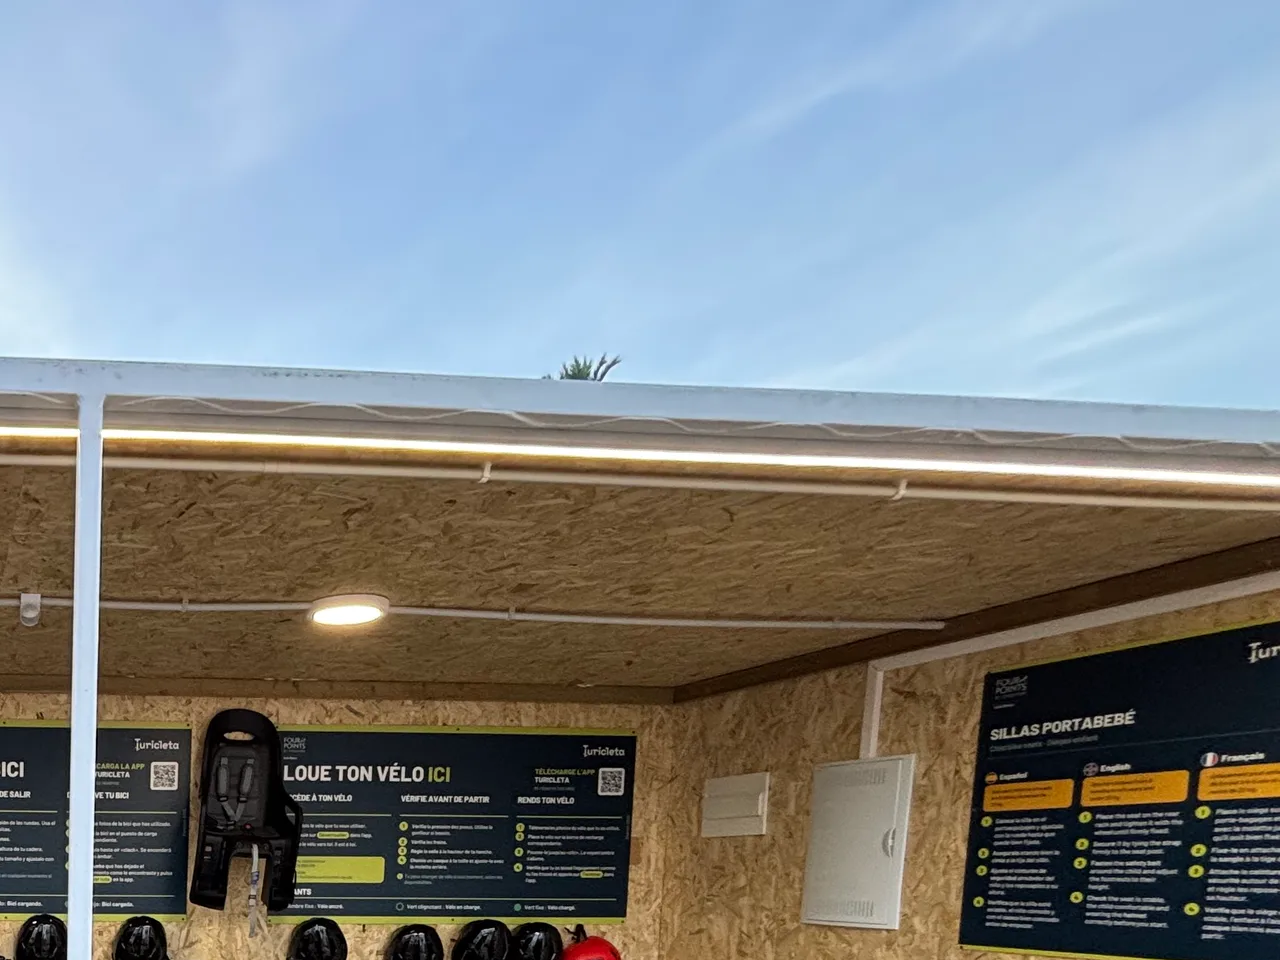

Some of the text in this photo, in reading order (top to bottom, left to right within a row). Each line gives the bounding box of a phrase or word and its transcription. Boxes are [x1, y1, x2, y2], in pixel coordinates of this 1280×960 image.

[990, 708, 1136, 740] SILLAS PORTABEBÉ
[135, 738, 179, 751] Turicleta
[583, 745, 625, 757] Turicleta
[1221, 752, 1265, 763] Français
[284, 763, 450, 782] LOUE TON VÉLO ICI
[1100, 763, 1131, 772] English
[311, 793, 317, 801] À
[401, 794, 427, 802] VÉRIFIE
[557, 796, 574, 804] VÉLO
